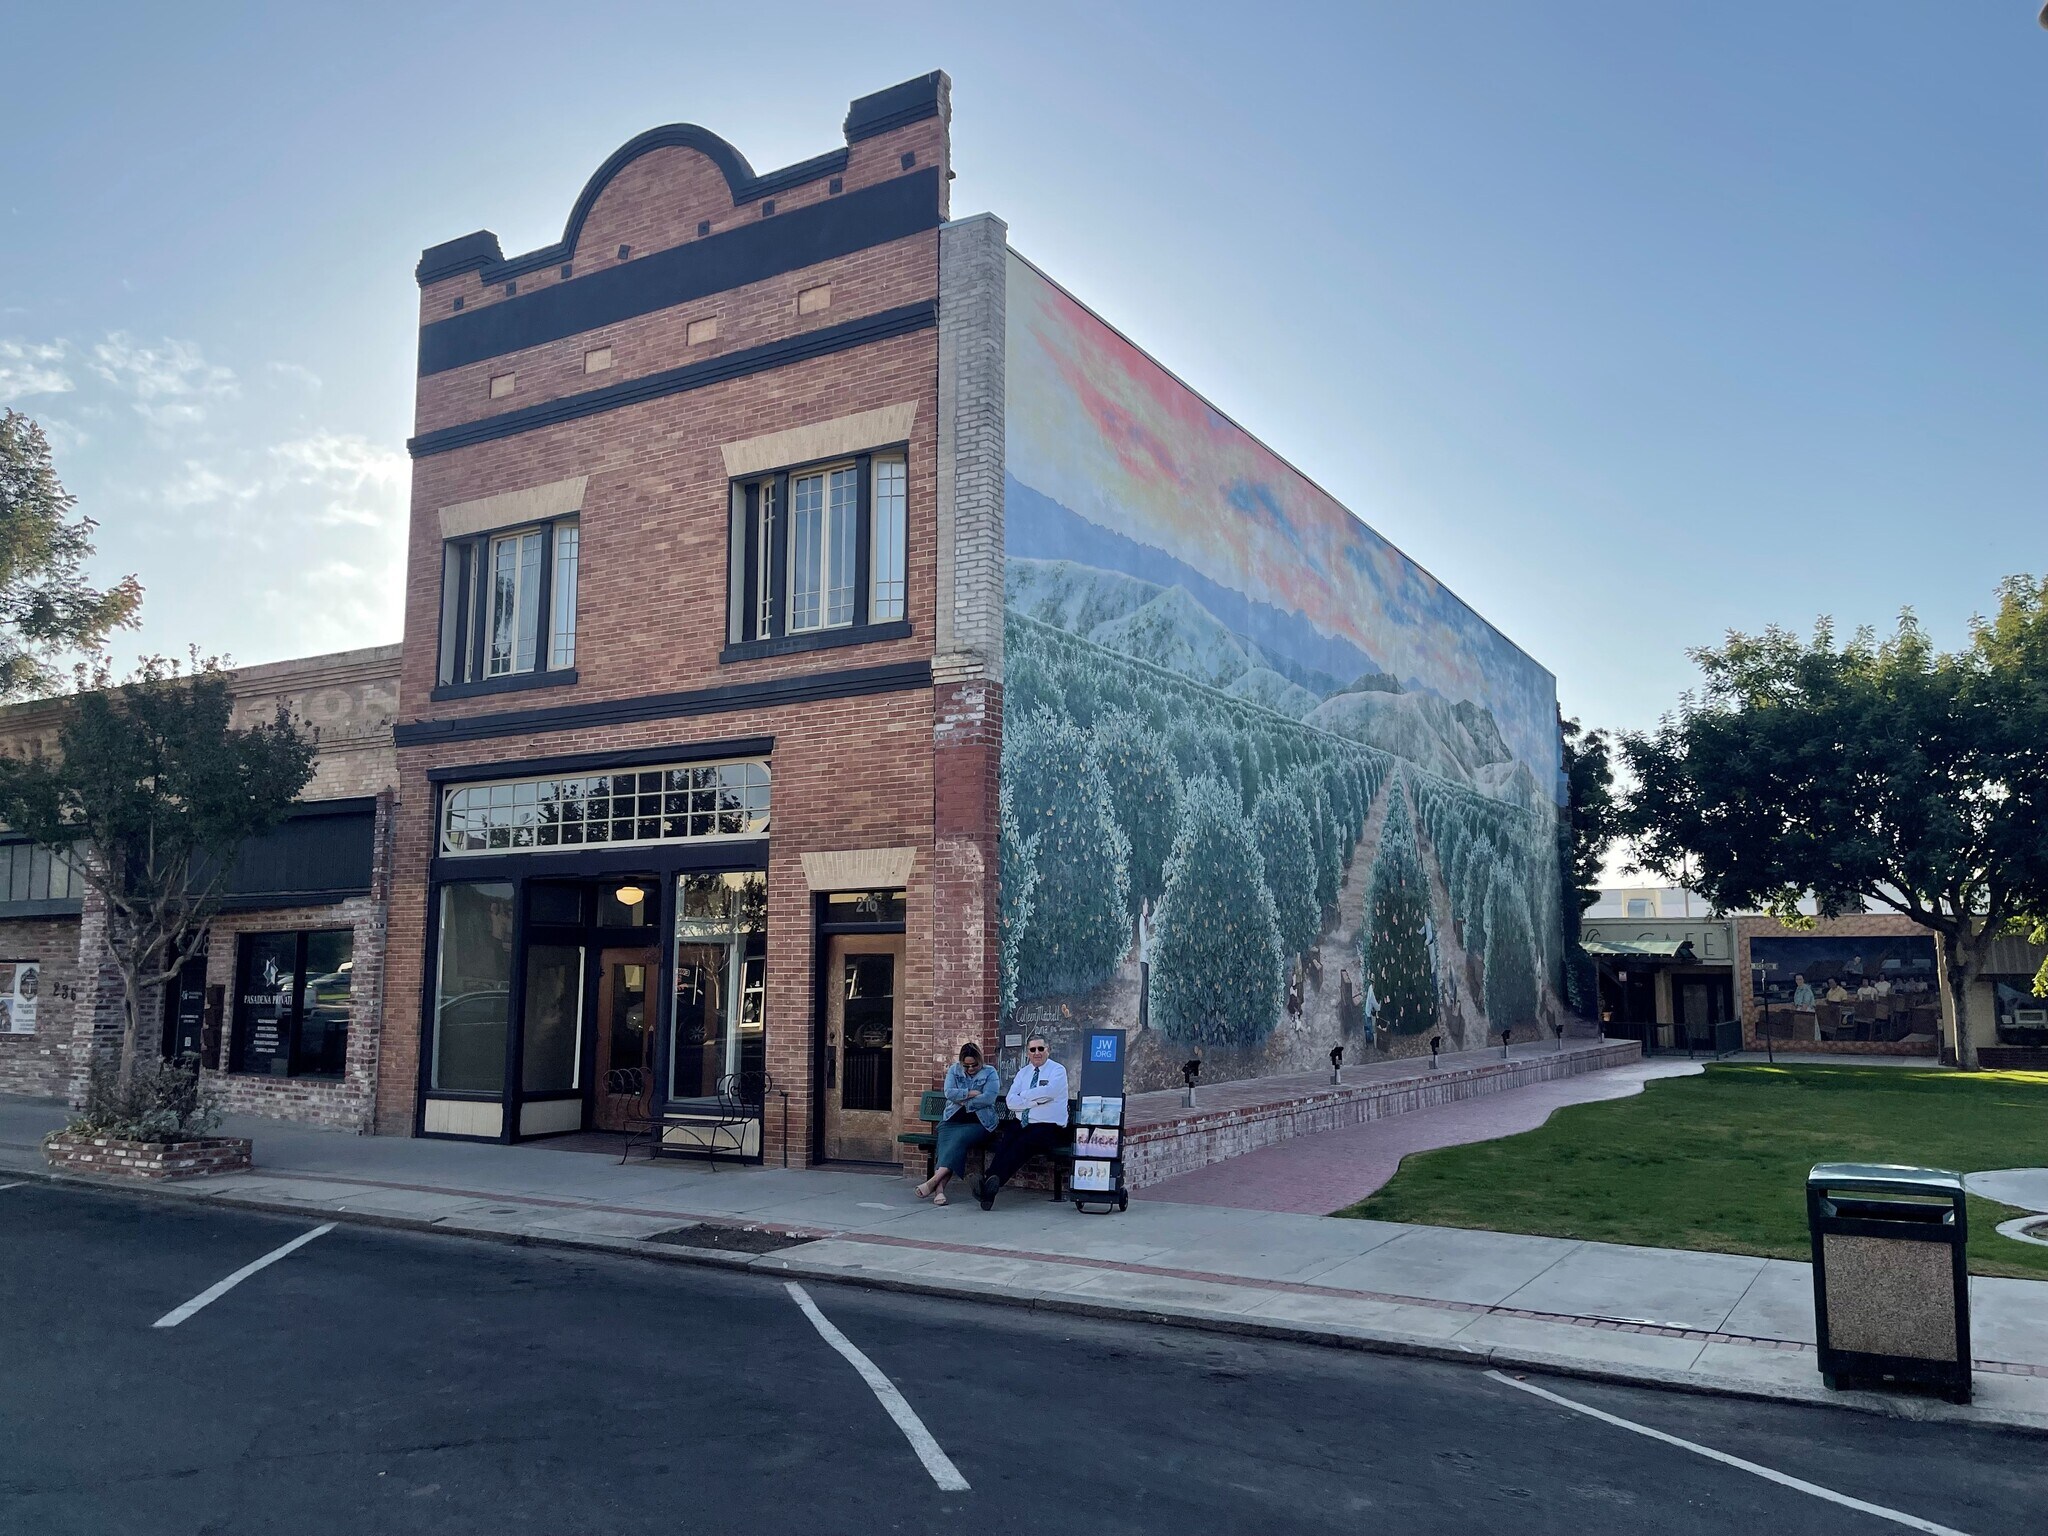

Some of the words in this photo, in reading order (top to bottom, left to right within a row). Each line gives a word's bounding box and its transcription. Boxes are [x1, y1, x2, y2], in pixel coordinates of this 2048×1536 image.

[855, 896, 878, 913] 216
[244, 995, 272, 1005] PASADENA
[1096, 1039, 1113, 1050] JW
[1094, 1050, 1112, 1058] .ORG
